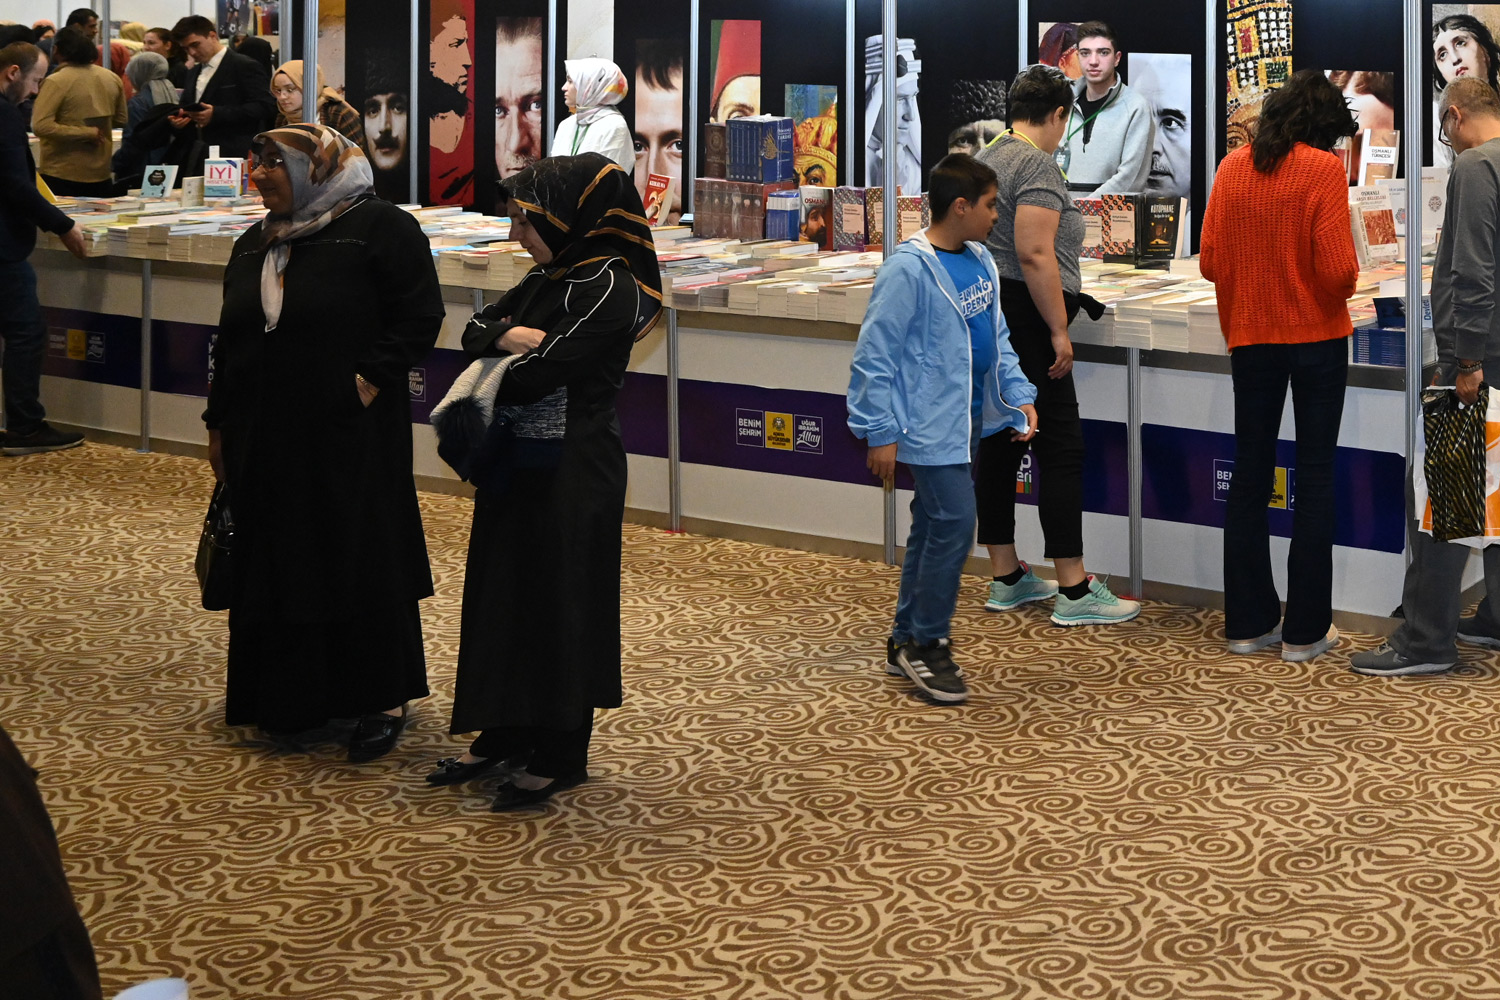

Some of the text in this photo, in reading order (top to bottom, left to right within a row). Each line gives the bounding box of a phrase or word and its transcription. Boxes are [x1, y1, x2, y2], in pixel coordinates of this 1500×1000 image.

[210, 165, 232, 179] İYİ
[738, 417, 761, 428] BENİM
[738, 428, 761, 438] ŞEHRİM
[798, 424, 819, 432] İBRAHİM
